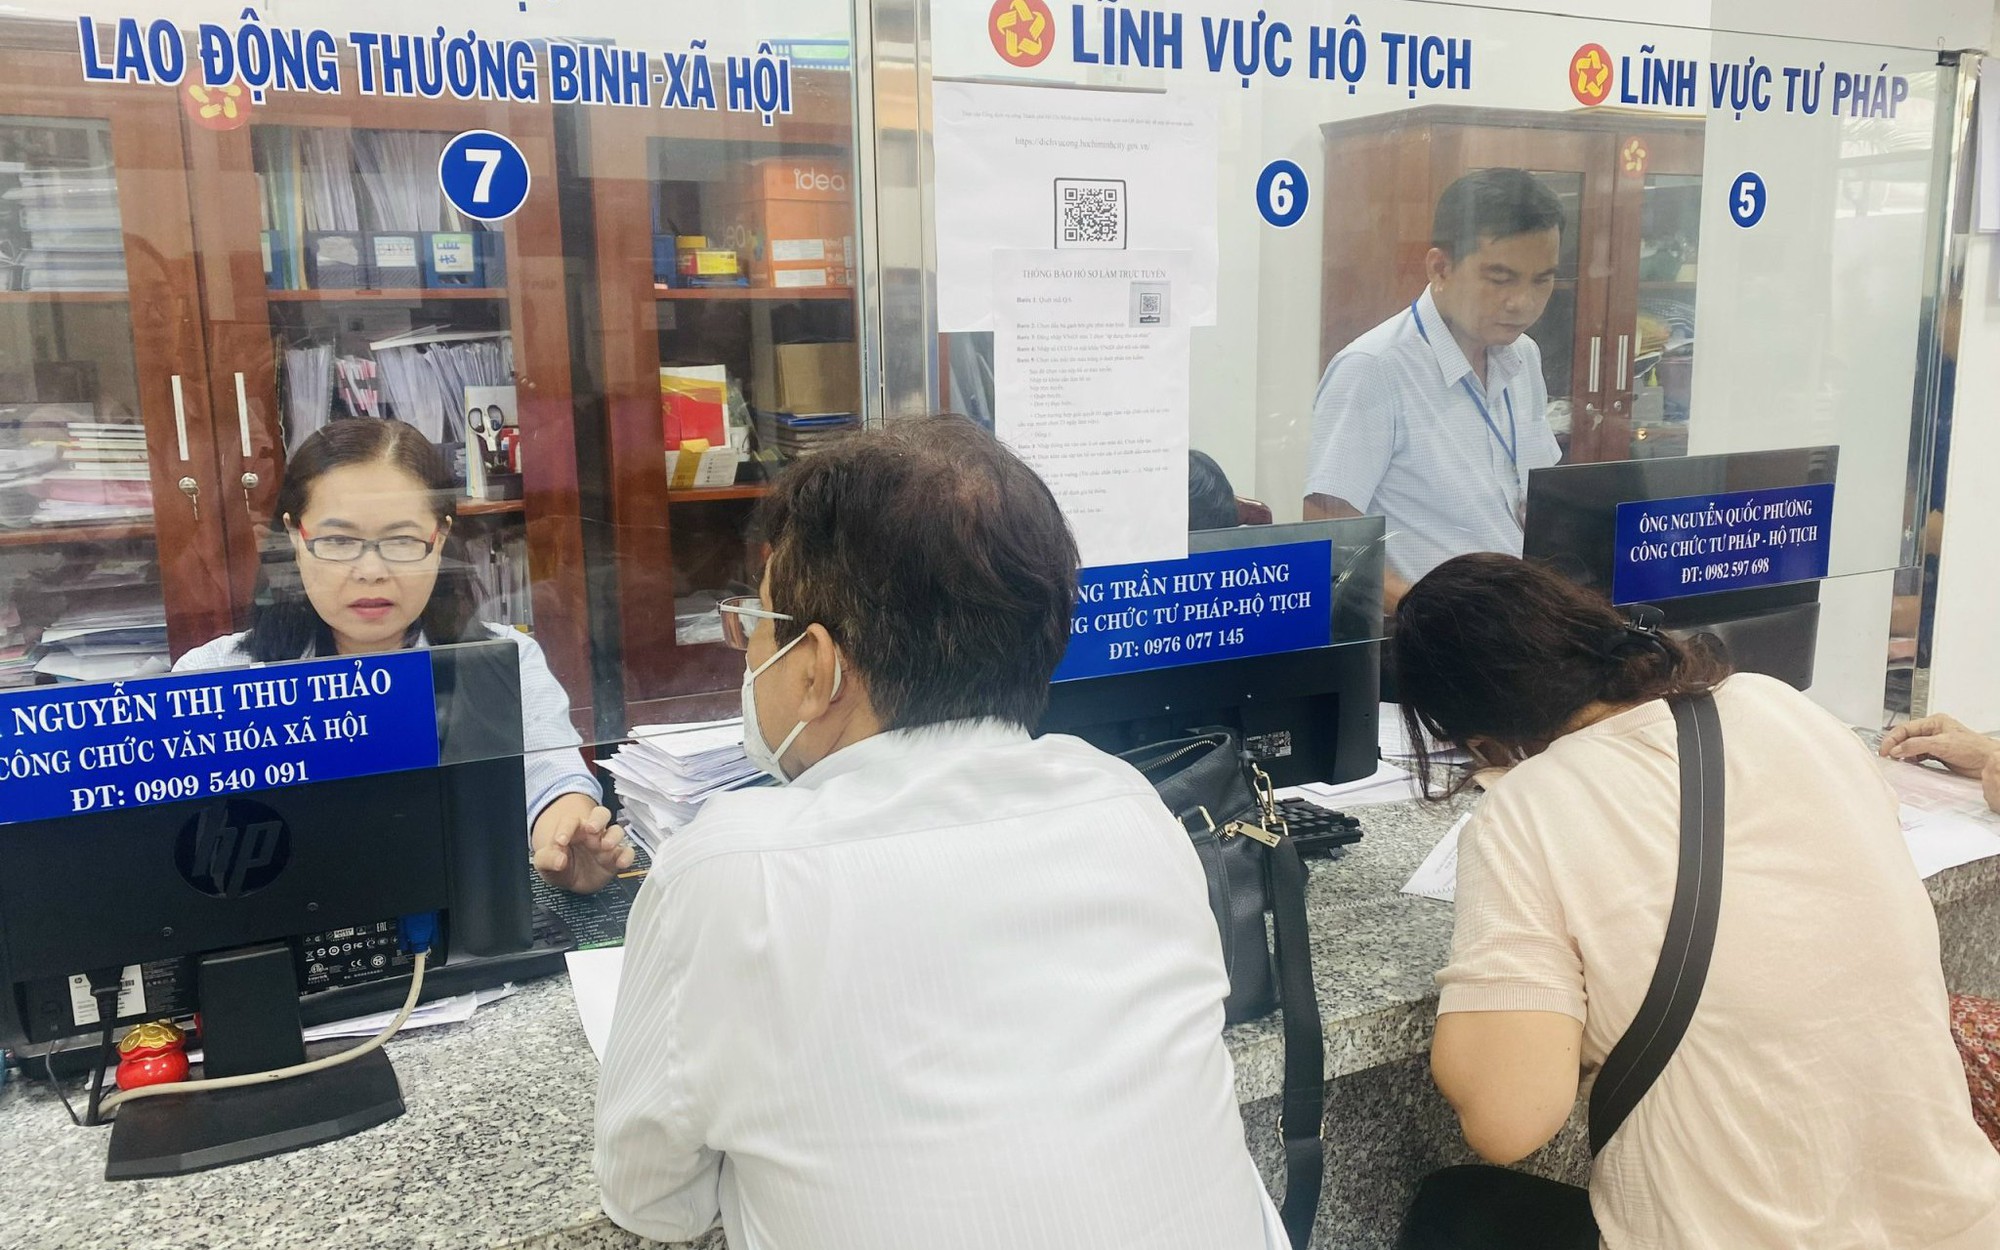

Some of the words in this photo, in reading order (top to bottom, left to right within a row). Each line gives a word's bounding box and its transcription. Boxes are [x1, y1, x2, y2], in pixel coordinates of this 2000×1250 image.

[81, 17, 184, 83] LAO
[200, 8, 339, 103] ĐỘNG
[350, 26, 536, 101] THƯƠNG
[728, 44, 791, 124] HỘI
[1202, 10, 1292, 88] VỰC
[1309, 15, 1366, 94] HỘ
[1381, 33, 1472, 98] TỊCH
[1620, 45, 1696, 107] LĨNH
[1710, 56, 1772, 121] VỰC
[1783, 62, 1825, 114] TƯ
[1832, 63, 1909, 119] PHÁP
[465, 148, 502, 203] 7
[793, 168, 846, 192] idea
[1270, 172, 1294, 216] 6
[1738, 182, 1757, 218] 5
[1638, 511, 1668, 534] ÔNG
[1671, 502, 1724, 531] NGUYỄN
[1726, 498, 1762, 528] QUỐC
[1764, 498, 1813, 521] PHƯƠNG
[1630, 540, 1668, 563] CÔNG
[1670, 535, 1707, 558] CHỨC
[1709, 533, 1727, 554] TƯ
[1728, 529, 1761, 552] PHÁP
[1769, 525, 1787, 549] HỘ
[1790, 525, 1818, 548] TỊCH
[1110, 568, 1168, 601] TRẦN
[1173, 572, 1215, 595] HUY
[1221, 562, 1290, 588] HOÀNG
[1681, 567, 1703, 585] ĐT:
[1705, 563, 1730, 581] 0982
[1731, 560, 1750, 577] 597
[1751, 557, 1770, 575] 698
[1094, 606, 1148, 632] CHỨC
[1153, 602, 1179, 625] TƯ
[1183, 594, 1265, 622] PHÁP-HỘ
[1269, 591, 1312, 614] TỊCH
[1109, 640, 1140, 660] ĐT:
[1144, 636, 1181, 656] 0976
[1186, 632, 1213, 650] 077
[1218, 627, 1245, 647] 145
[11, 681, 157, 736] NGUYỄN
[166, 687, 226, 722] THỊ
[233, 677, 299, 711] THU
[307, 659, 392, 702] THẢO
[0, 748, 71, 781] CÔNG
[79, 733, 155, 770] CHỨC
[161, 729, 216, 759] VĂN
[223, 722, 279, 752] HÓA
[283, 715, 317, 745] XÃ
[324, 711, 369, 739] HỘI
[71, 784, 126, 812] ĐT:
[134, 775, 199, 803] 0909
[209, 767, 256, 793] 540
[264, 760, 309, 786] 091
[190, 799, 284, 898] hp
